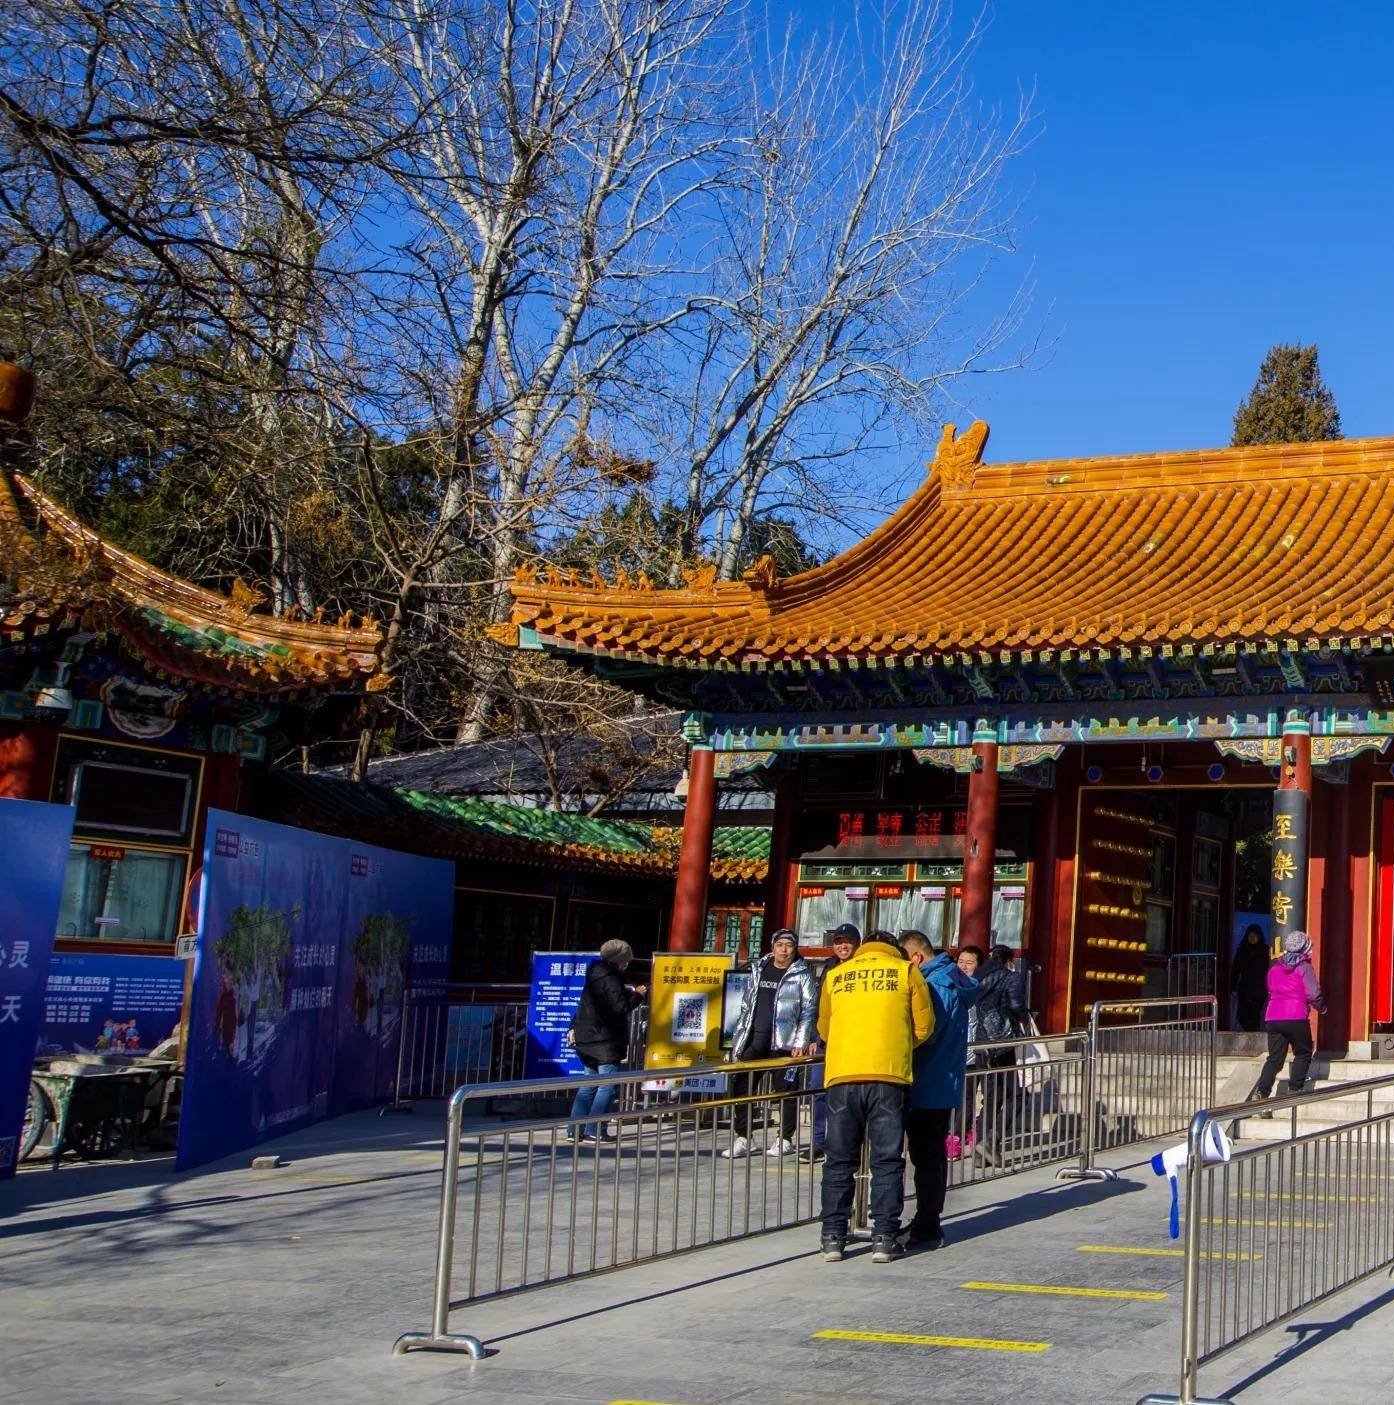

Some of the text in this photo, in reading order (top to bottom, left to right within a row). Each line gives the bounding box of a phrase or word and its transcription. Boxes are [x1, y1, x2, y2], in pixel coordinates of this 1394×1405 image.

[833, 968, 899, 987] 美团订门票
